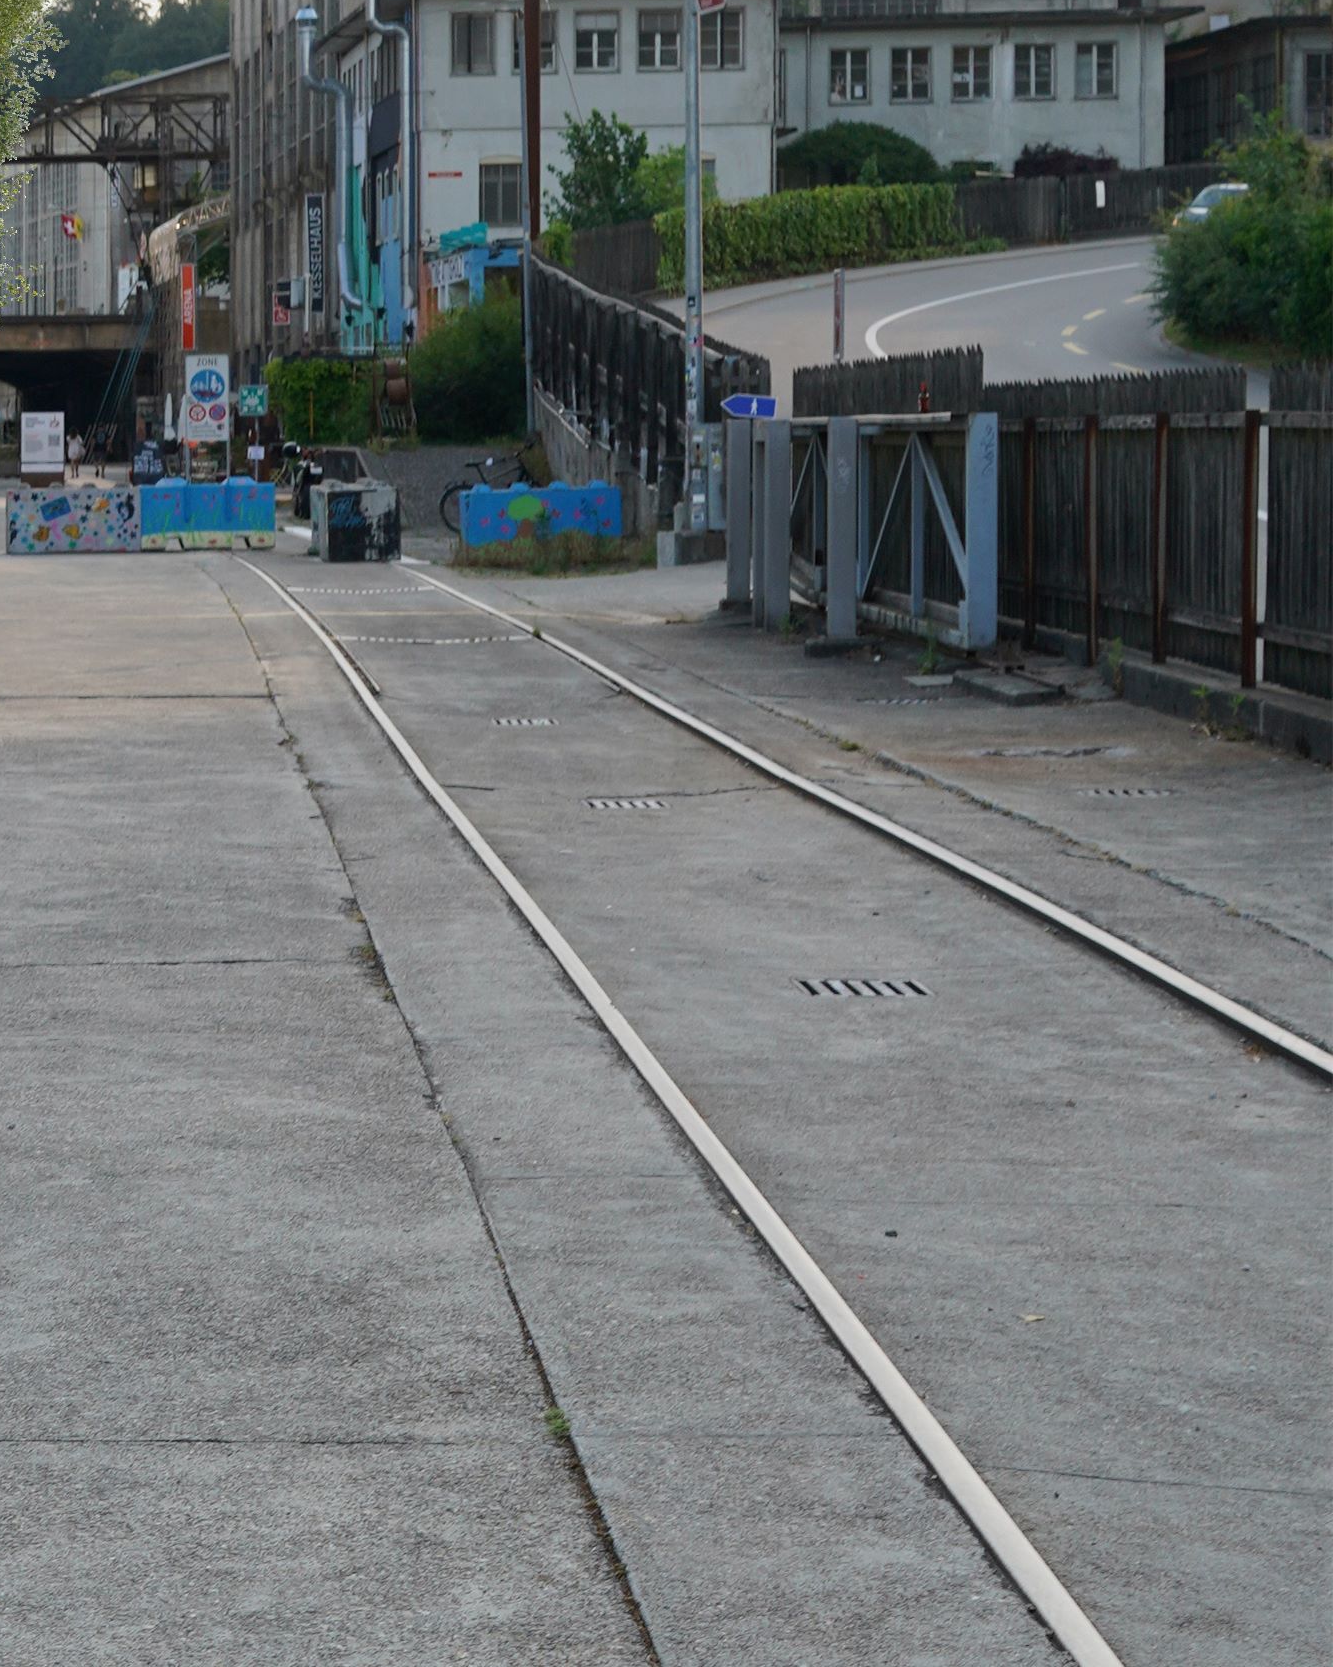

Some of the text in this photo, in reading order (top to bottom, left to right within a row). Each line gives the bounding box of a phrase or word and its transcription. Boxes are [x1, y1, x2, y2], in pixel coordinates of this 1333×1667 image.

[309, 206, 322, 299] KESSELHAUS
[182, 288, 194, 324] ARENA
[196, 357, 218, 367] ZONE
